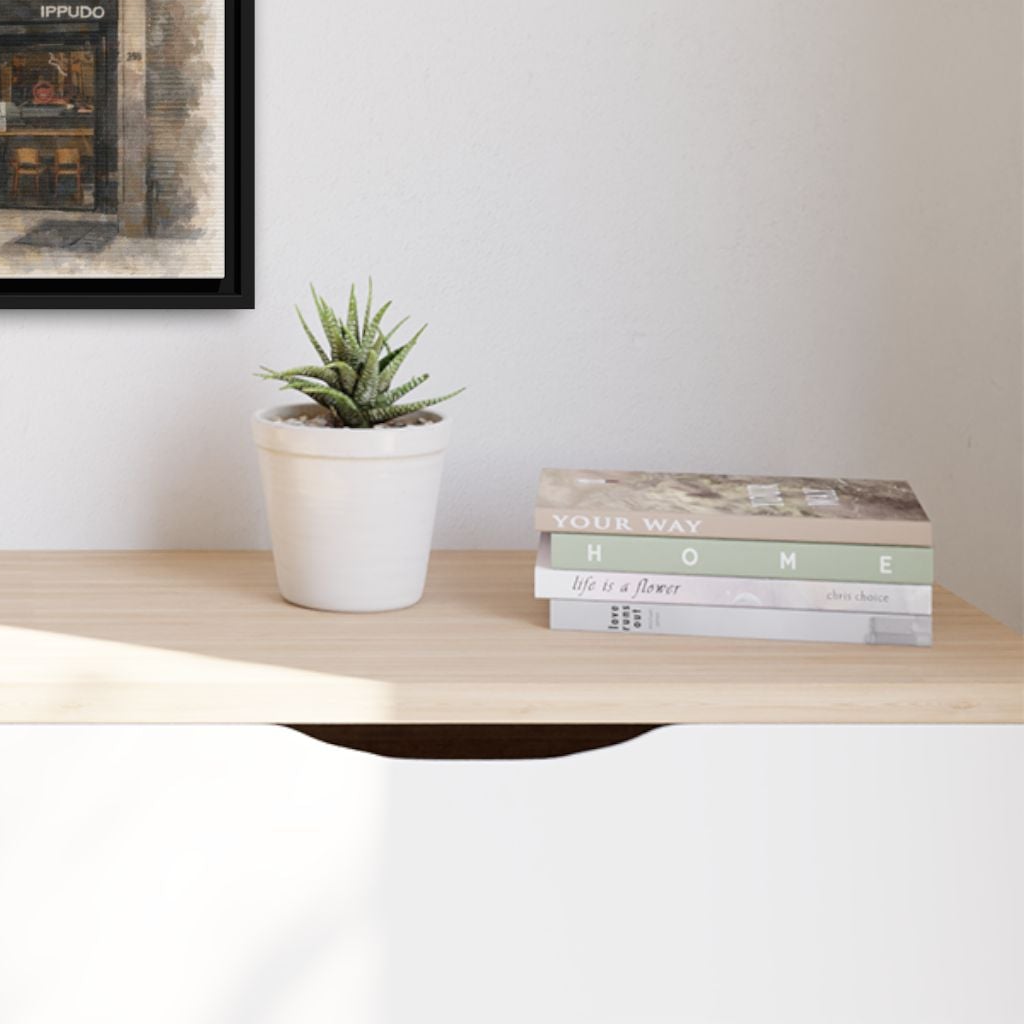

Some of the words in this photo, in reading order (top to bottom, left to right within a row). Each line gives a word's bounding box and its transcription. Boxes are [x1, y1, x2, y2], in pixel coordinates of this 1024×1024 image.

[40, 5, 105, 19] IPPUDO
[552, 515, 632, 531] YOUR
[643, 518, 703, 533] WAY
[572, 576, 596, 596] life
[602, 579, 614, 592] is
[619, 583, 629, 593] a
[632, 578, 682, 599] flower
[826, 589, 852, 601] chris
[854, 590, 890, 603] choice
[608, 605, 619, 630] love
[622, 605, 631, 631] runs
[632, 609, 642, 629] out
